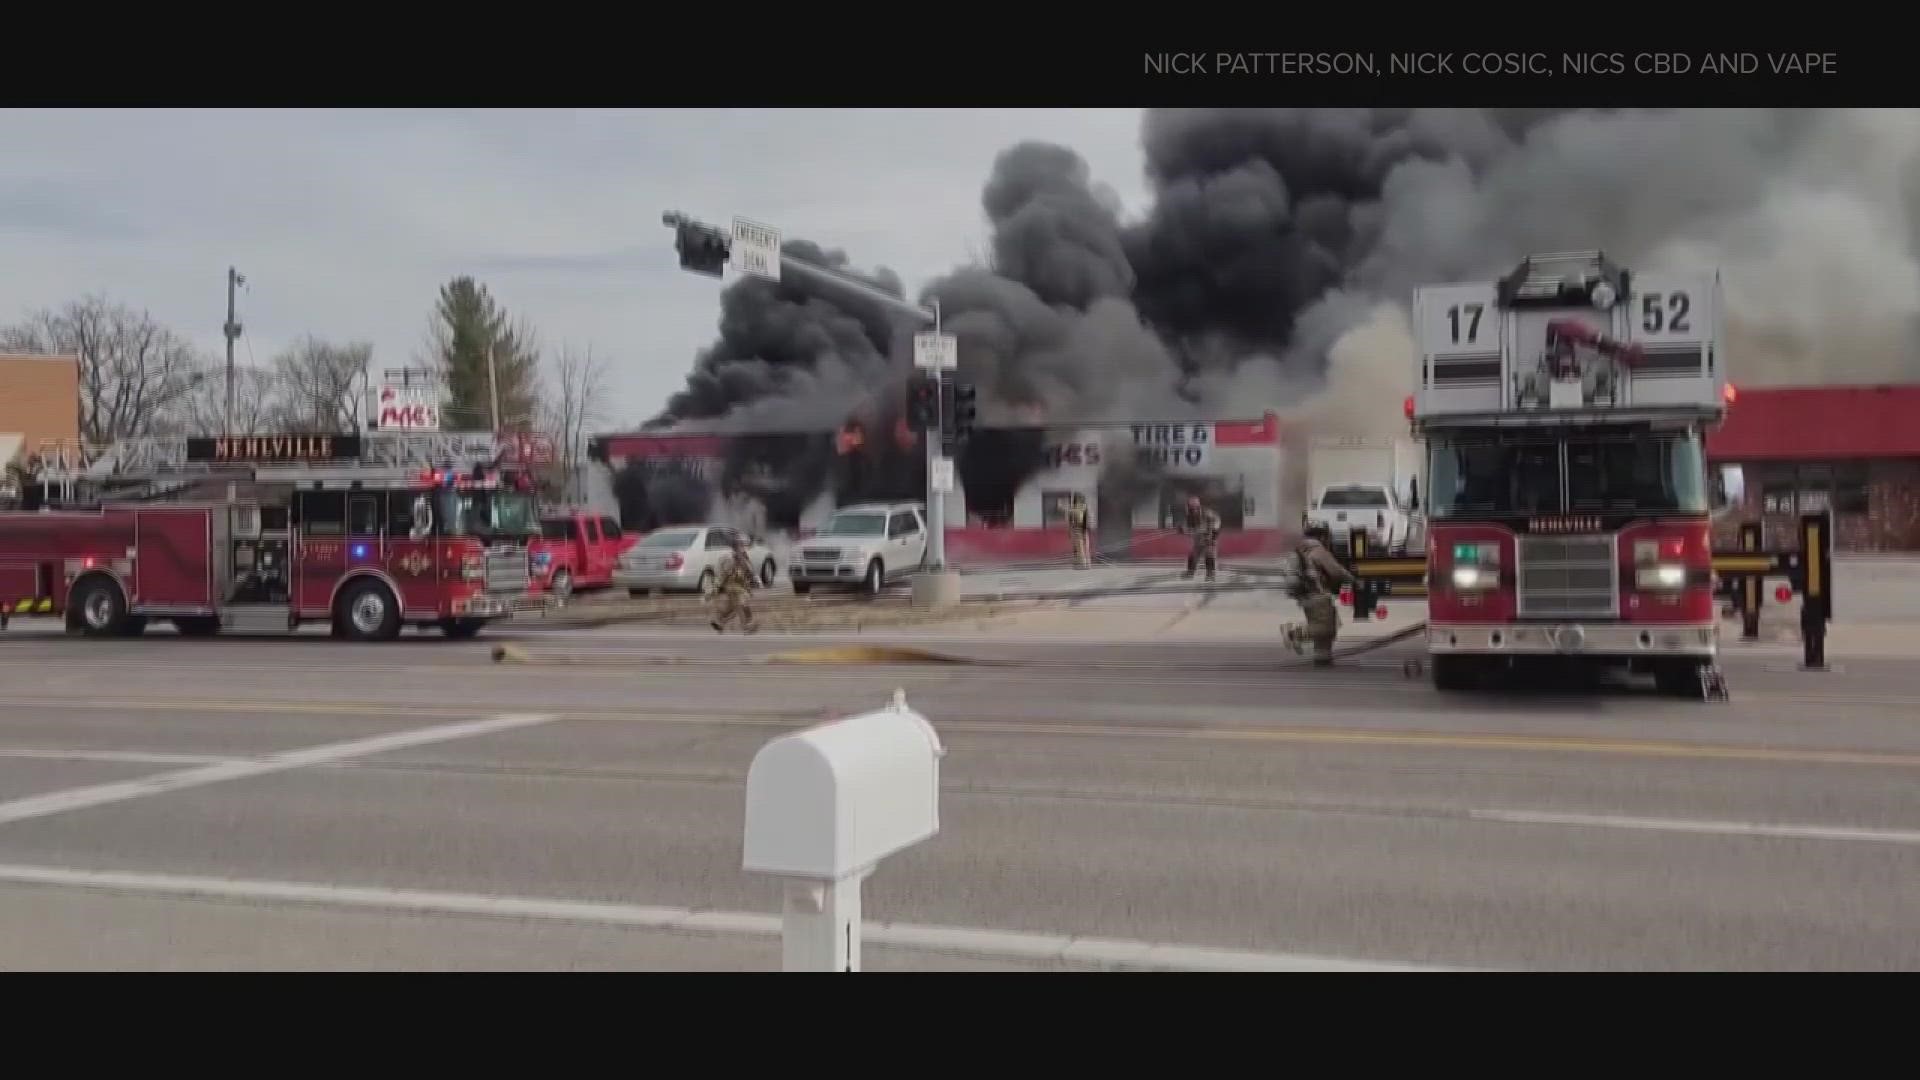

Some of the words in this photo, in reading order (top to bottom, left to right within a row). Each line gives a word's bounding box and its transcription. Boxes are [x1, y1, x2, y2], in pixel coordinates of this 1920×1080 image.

[735, 222, 778, 250] EMERGENCY
[743, 248, 768, 270] SIGNAL
[1448, 303, 1485, 344] 17
[1642, 291, 1690, 333] 52
[1130, 424, 1185, 445] TIRE
[215, 437, 332, 458] MEHLVILLE
